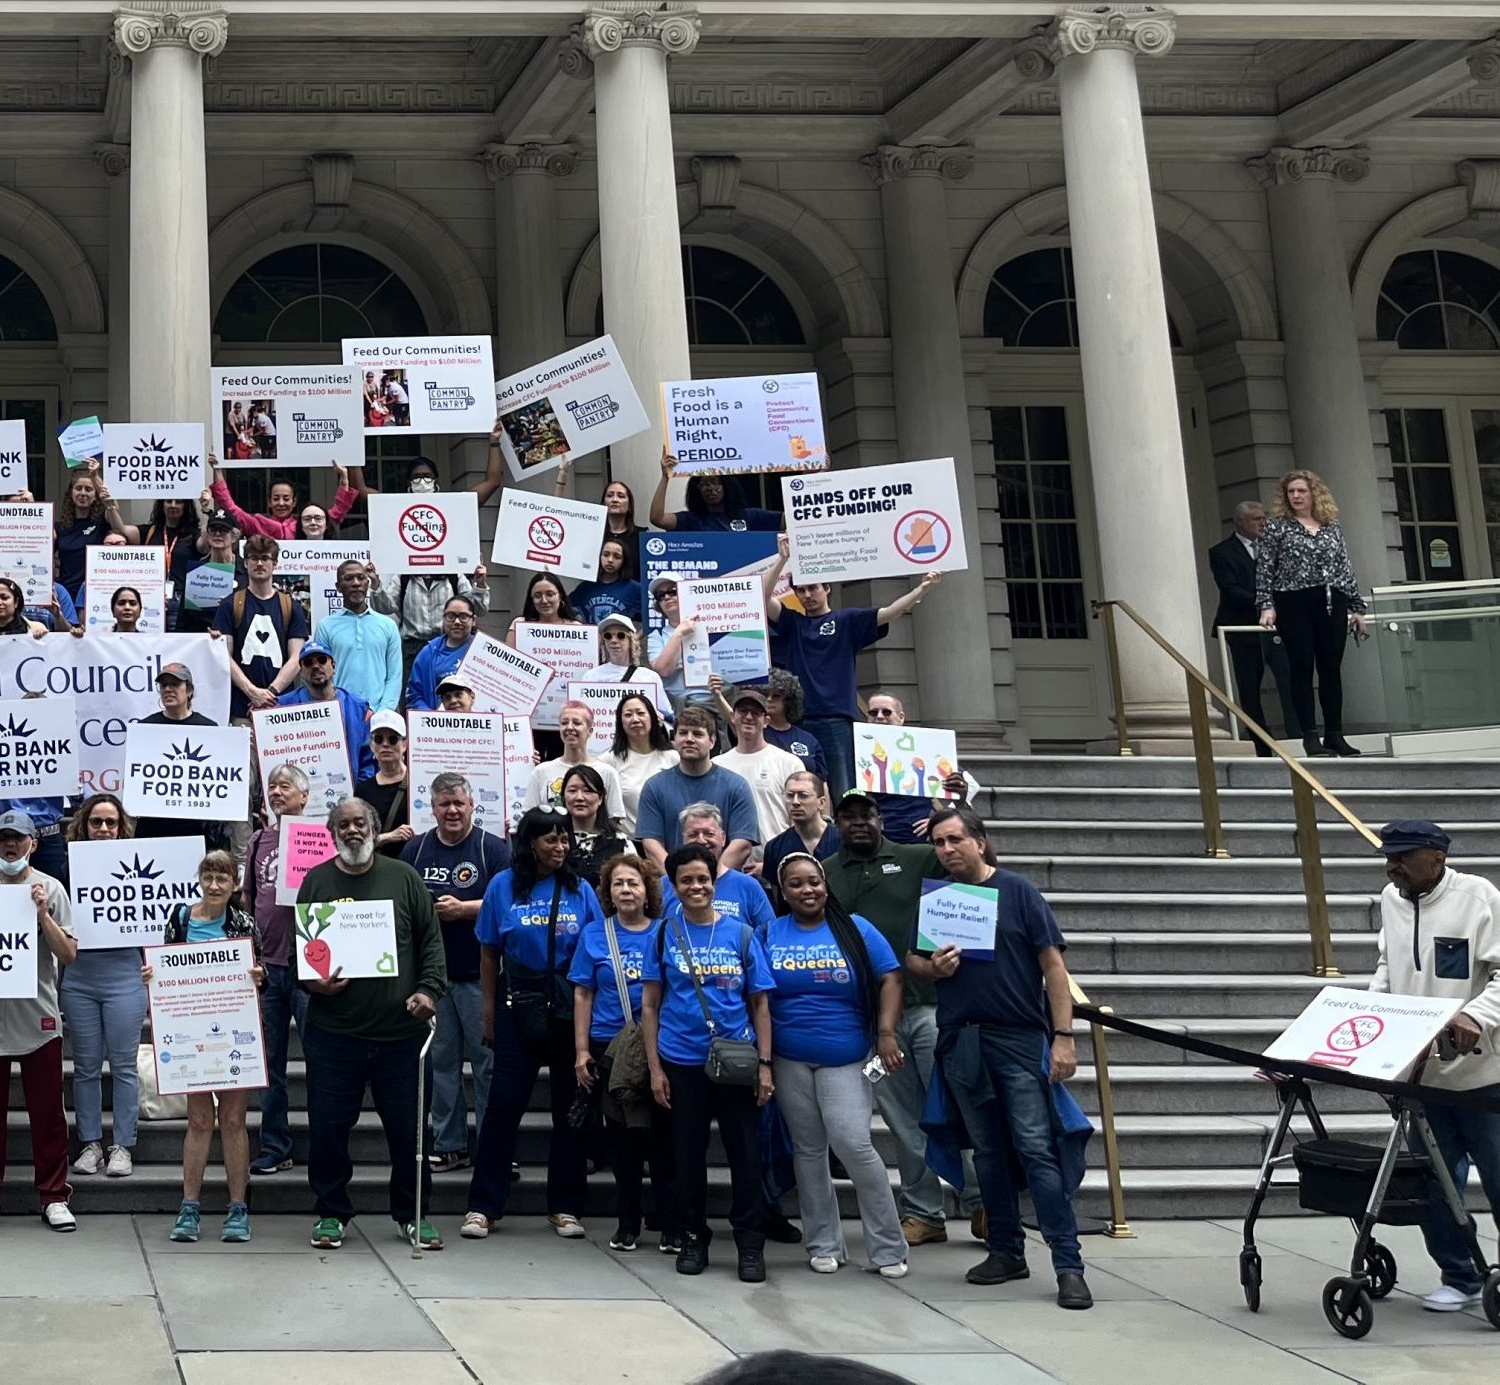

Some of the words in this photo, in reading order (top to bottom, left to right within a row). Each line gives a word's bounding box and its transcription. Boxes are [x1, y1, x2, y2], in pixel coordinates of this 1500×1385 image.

[353, 346, 379, 356] Feed
[382, 347, 402, 355] Our
[405, 345, 481, 355] Communities!
[222, 376, 248, 386] Feed
[251, 376, 272, 385] Our
[275, 374, 352, 385] Communities!
[431, 388, 467, 398] COMMON
[672, 386, 715, 398] Fresh
[432, 400, 464, 409] PANTRY
[674, 401, 715, 412] Food
[716, 400, 729, 410] is
[734, 401, 743, 409] a
[299, 421, 335, 430] COMMON
[675, 416, 729, 427] Human
[300, 432, 334, 441] PANTRY
[676, 429, 722, 443] Right,
[678, 448, 742, 461] PERIOD.
[108, 456, 151, 468] FOOD
[155, 455, 199, 467] BANK
[118, 470, 151, 482] FOR
[156, 470, 188, 482] NYC
[792, 491, 843, 507] HANDS
[849, 487, 876, 500] OFF
[882, 483, 912, 497] OUR
[412, 511, 433, 519] CFC
[509, 500, 527, 509] Feed
[529, 503, 544, 511] Our
[545, 506, 599, 521] Communities!
[793, 507, 822, 520] CFC
[827, 499, 896, 517] FUNDING!
[402, 523, 444, 532] Funding
[102, 552, 155, 561] ROUNDTABLE
[647, 561, 668, 570] THE
[671, 561, 718, 570] DEMAND
[692, 582, 752, 595] ROUNDTABLE
[696, 602, 715, 611] $100
[718, 600, 747, 608] Million
[530, 629, 588, 640] ROUNDTABLE
[532, 647, 552, 655] $100
[554, 648, 581, 656] Million
[484, 642, 541, 677] ROUNDTABLE
[559, 661, 594, 669] Funding
[15, 655, 162, 695] Council
[268, 707, 330, 725] ROUNDTABLE
[425, 717, 491, 730] ROUNDTABLE
[274, 733, 294, 742] $100
[297, 729, 326, 739] Million
[15, 739, 71, 756] BANK
[263, 746, 302, 757] Baseline
[304, 740, 341, 751] Funding
[16, 759, 57, 775] NYC
[130, 763, 185, 779] FOOD
[189, 765, 243, 781] BANK
[142, 781, 182, 797] FOR
[186, 784, 228, 799] NYC
[297, 830, 326, 838] HUNGER
[424, 867, 449, 881] 125
[77, 885, 136, 903] FOOD
[141, 882, 201, 900] BANK
[937, 898, 956, 911] Fully
[958, 902, 979, 911] Fund
[341, 912, 354, 920] We
[927, 908, 958, 919] Hunger
[961, 913, 988, 924] Relief!
[340, 921, 357, 929] New
[359, 920, 389, 929] Yorkers.
[164, 949, 240, 968] ROUNDTABLE
[771, 950, 840, 961] Brooklyn
[158, 980, 176, 988] $100
[178, 977, 209, 986] MILLION
[227, 974, 246, 982] CFC!
[1323, 999, 1348, 1007] Feed
[1349, 1002, 1369, 1010] Our
[1371, 1005, 1443, 1017] Communities!
